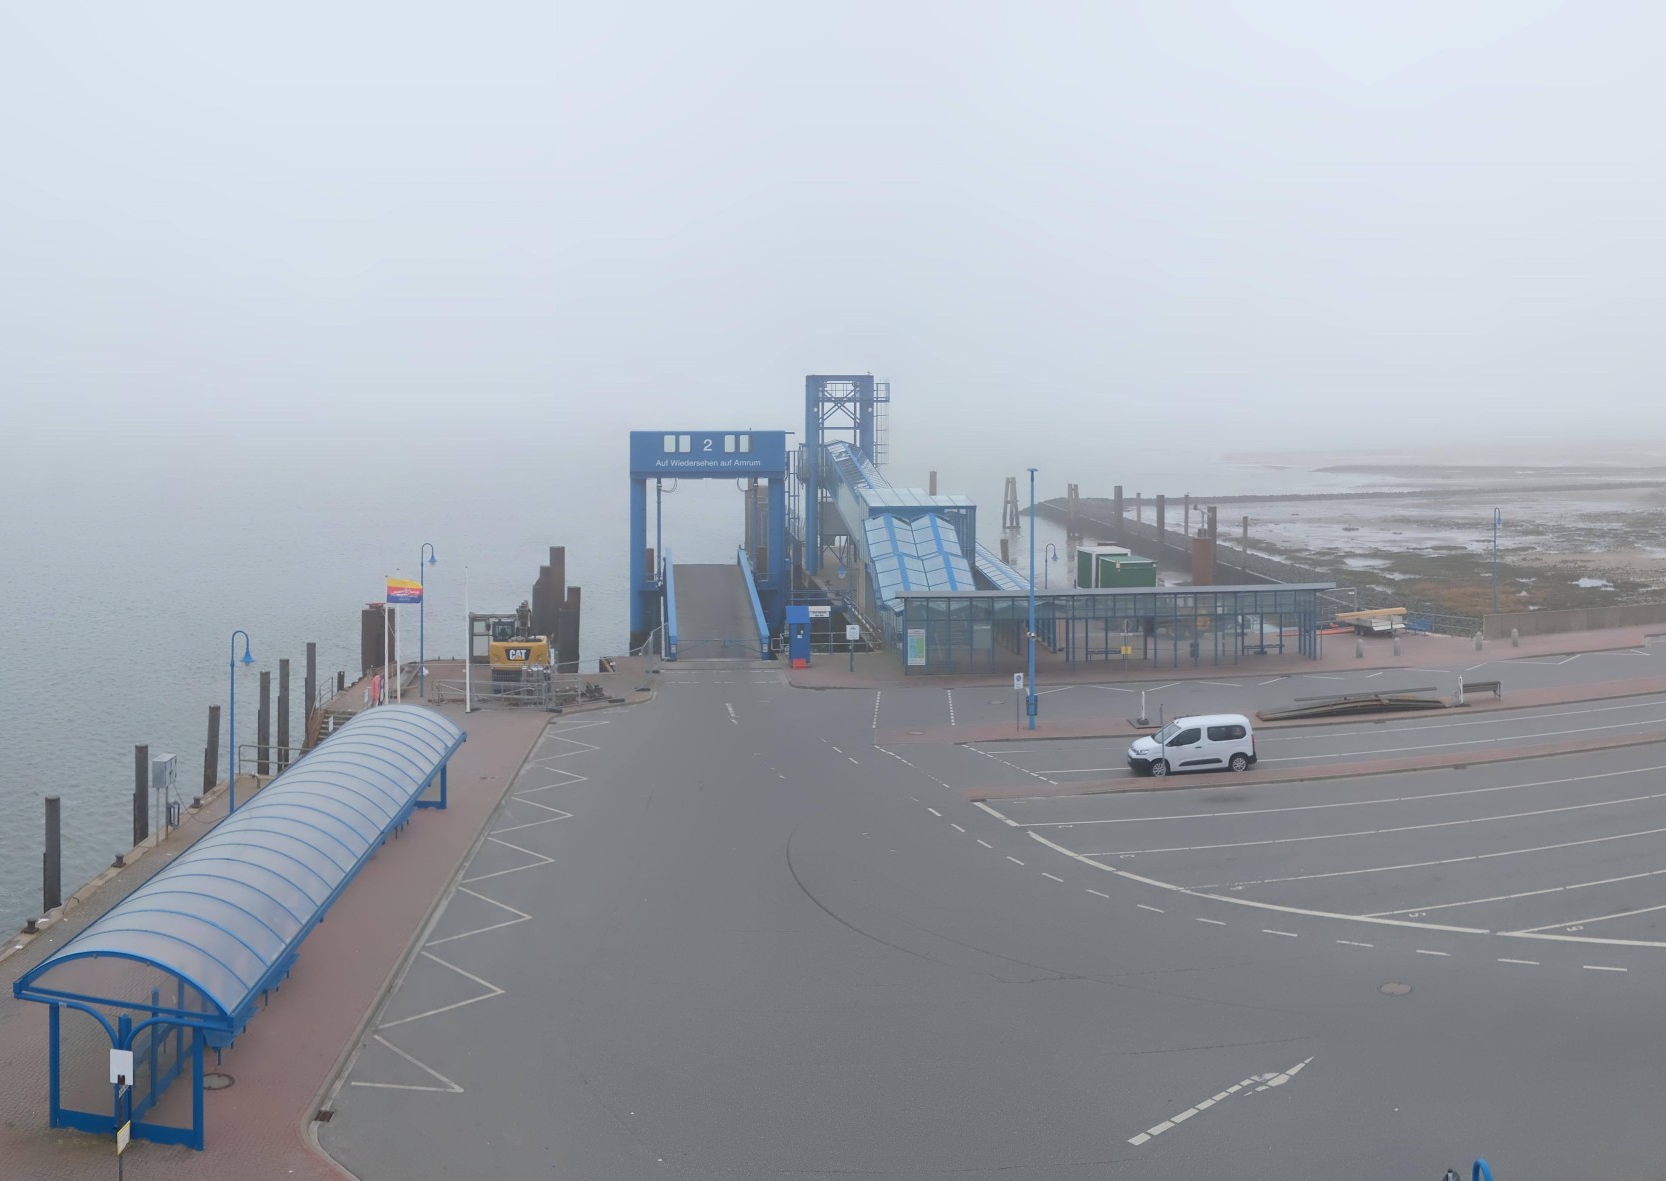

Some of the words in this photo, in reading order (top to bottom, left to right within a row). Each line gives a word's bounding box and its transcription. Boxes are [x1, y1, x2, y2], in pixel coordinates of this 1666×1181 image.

[703, 439, 713, 451] 2
[670, 459, 719, 467] Wiedersehen
[720, 459, 733, 467] auf
[734, 459, 761, 467] Amrum
[509, 649, 526, 660] CAT
